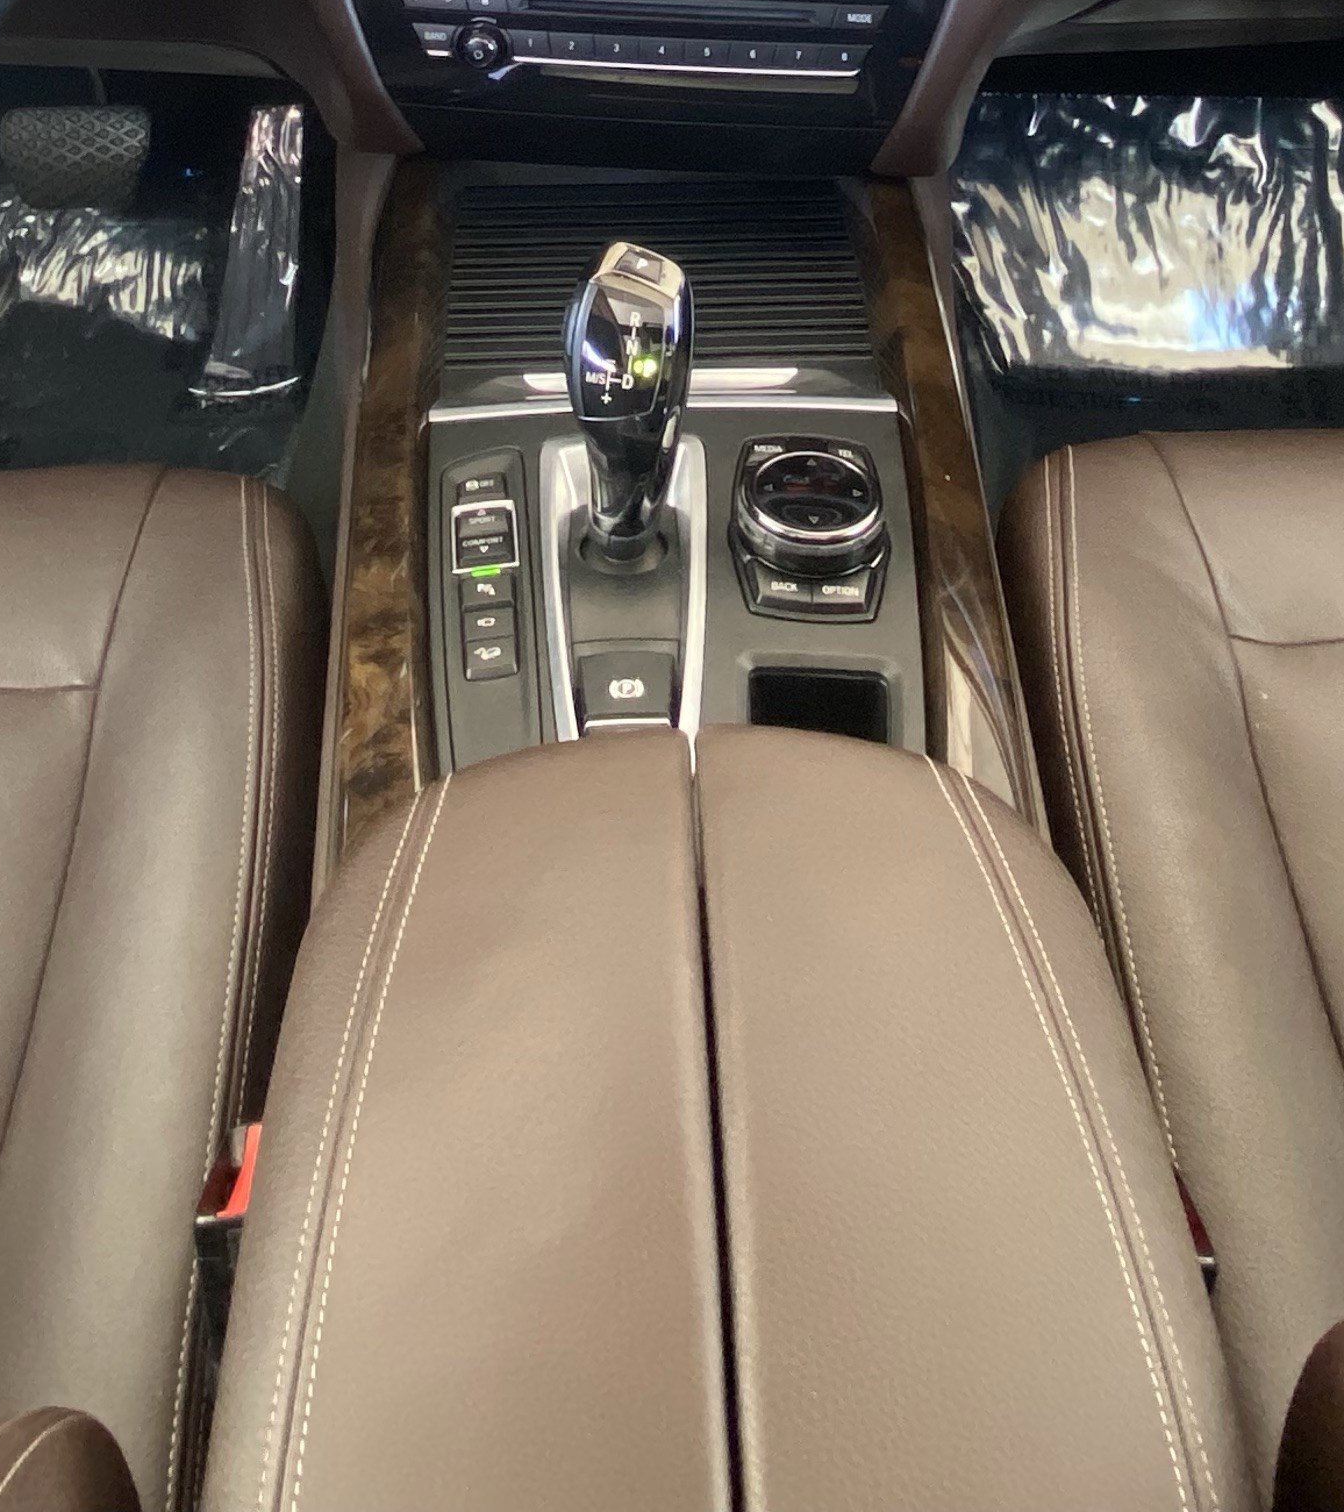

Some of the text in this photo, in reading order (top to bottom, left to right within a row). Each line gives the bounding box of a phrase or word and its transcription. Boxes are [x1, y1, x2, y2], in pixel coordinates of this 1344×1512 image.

[847, 12, 873, 24] MODE
[568, 40, 576, 51] 2
[612, 42, 621, 54] 3
[658, 44, 665, 55] 4
[795, 50, 802, 60] 7
[635, 256, 648, 271] P
[629, 311, 642, 328] R
[626, 339, 639, 357] N
[621, 374, 634, 390] D
[770, 581, 799, 592] BACK
[821, 584, 860, 597] OPTION
